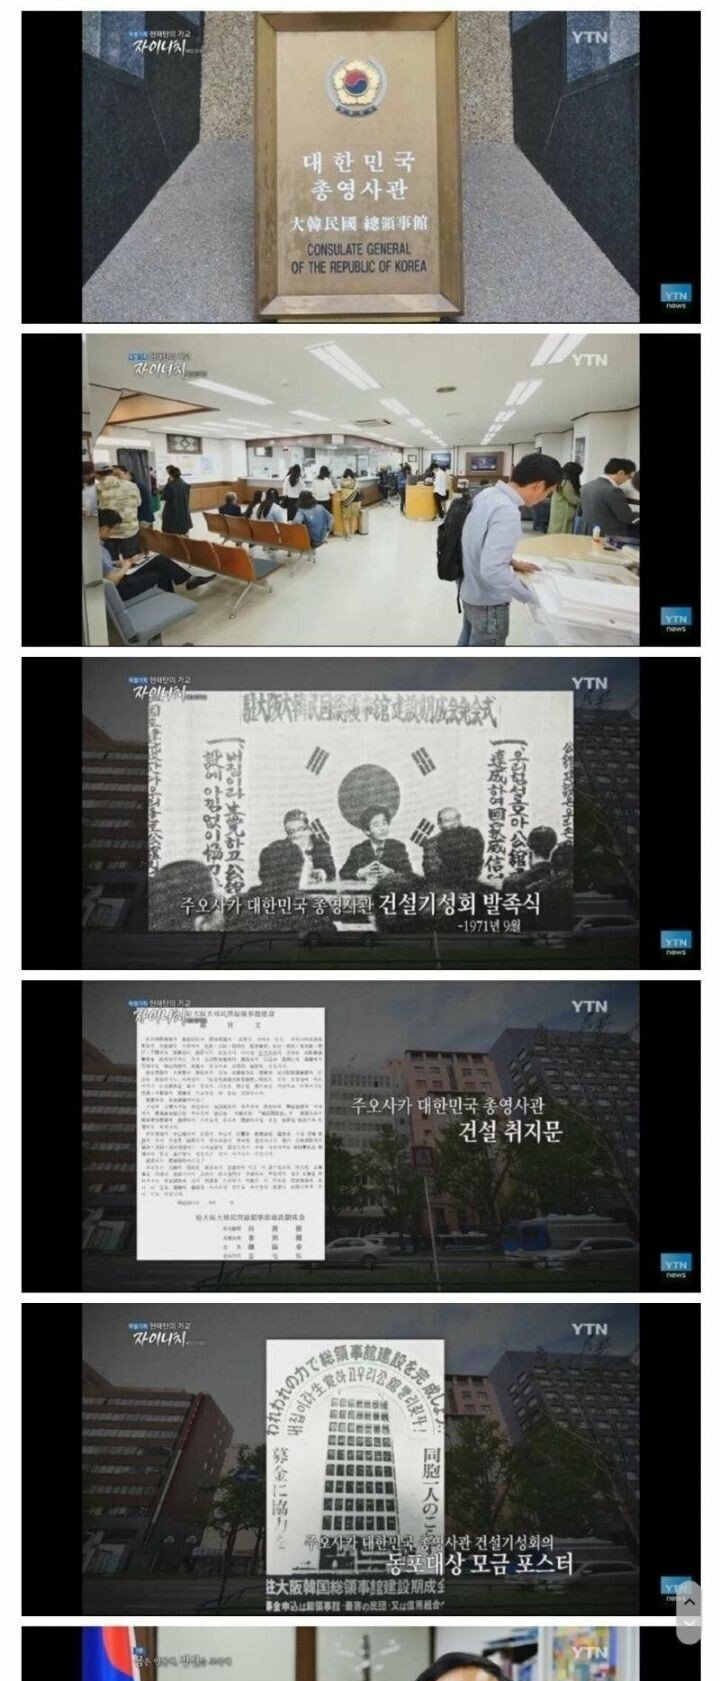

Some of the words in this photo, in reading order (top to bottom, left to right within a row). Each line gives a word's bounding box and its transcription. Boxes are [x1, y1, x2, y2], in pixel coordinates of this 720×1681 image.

[303, 150, 416, 174] 대한민국
[310, 178, 409, 202] 총영사관
[289, 215, 357, 233] 大韓民國
[307, 243, 363, 256] CONSULATE
[366, 242, 412, 255] GENERAL
[291, 261, 304, 274] OF
[308, 261, 329, 274] THE
[330, 260, 376, 274] REPUBLIC
[378, 260, 392, 273] OF
[395, 259, 427, 272] KOREA
